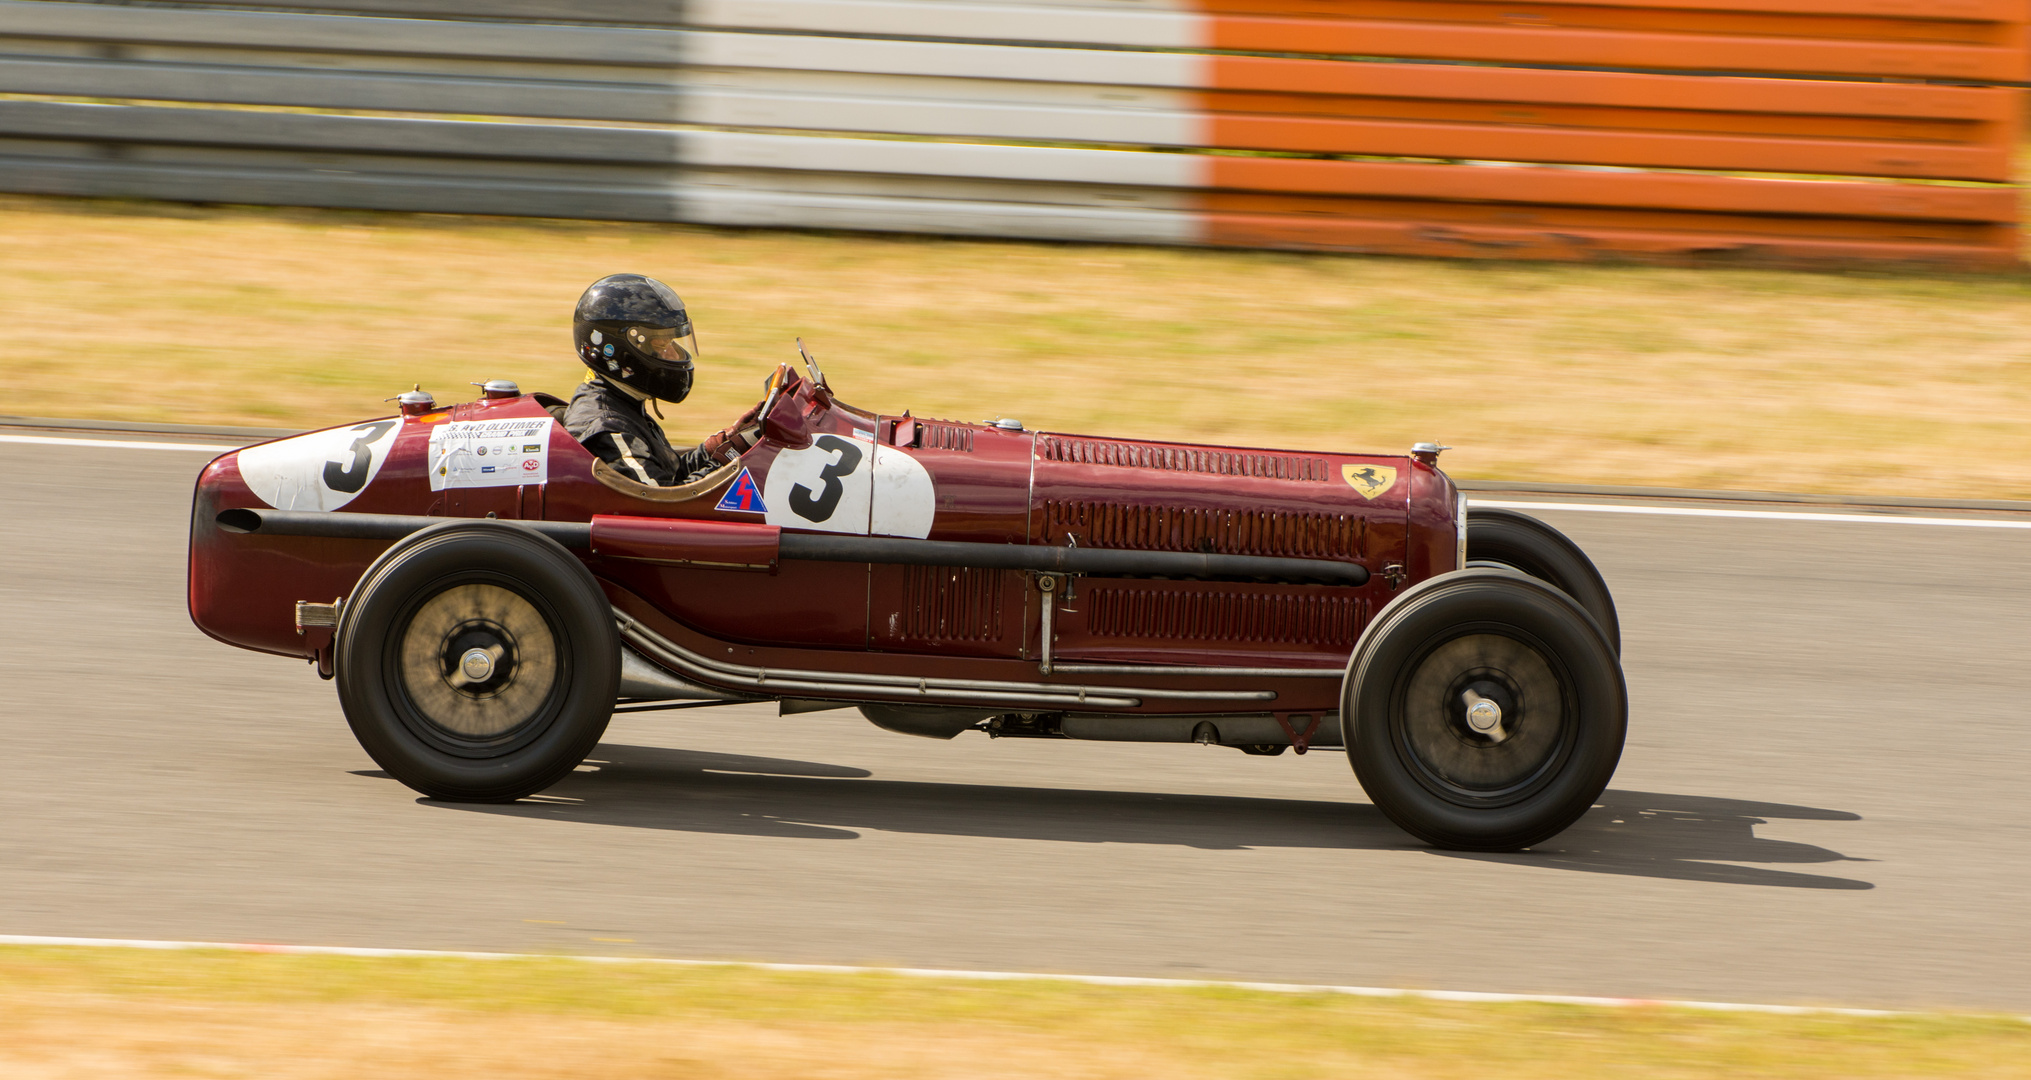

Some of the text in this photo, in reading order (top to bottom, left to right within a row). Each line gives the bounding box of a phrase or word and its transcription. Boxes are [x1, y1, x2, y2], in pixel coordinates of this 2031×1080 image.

[323, 421, 396, 493] 3
[486, 421, 546, 430] OLDTIMER
[788, 435, 863, 523] 3
